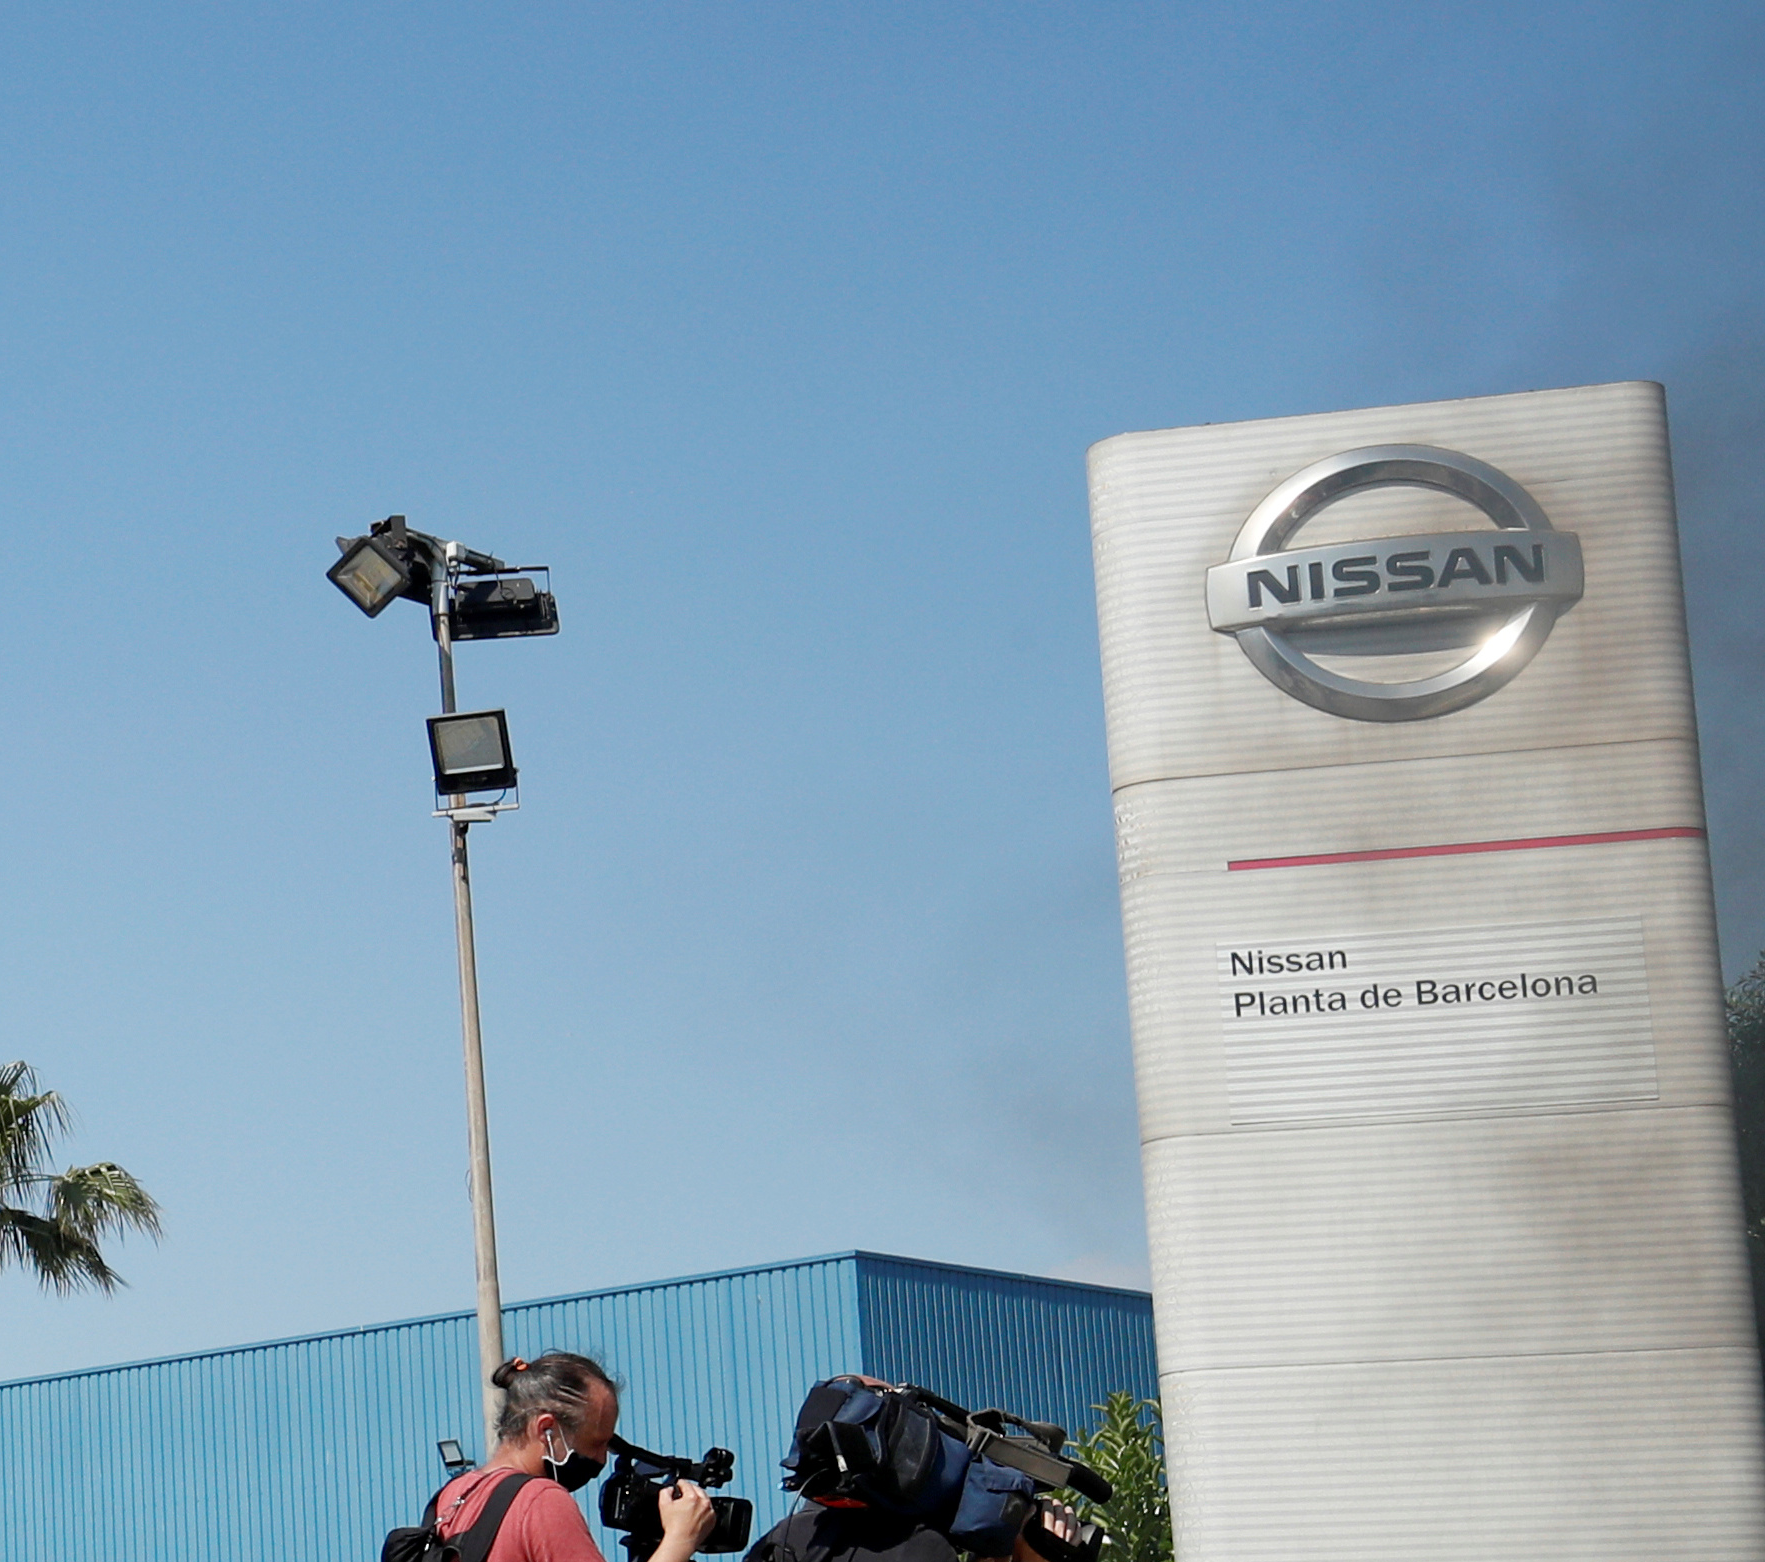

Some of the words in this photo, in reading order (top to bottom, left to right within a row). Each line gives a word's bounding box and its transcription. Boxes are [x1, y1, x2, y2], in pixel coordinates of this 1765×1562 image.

[1246, 543, 1546, 610] NISSAN
[1230, 949, 1348, 977] Nissan
[1234, 988, 1347, 1017] Planta
[1359, 983, 1403, 1009] de
[1415, 972, 1599, 1006] Barcelona
